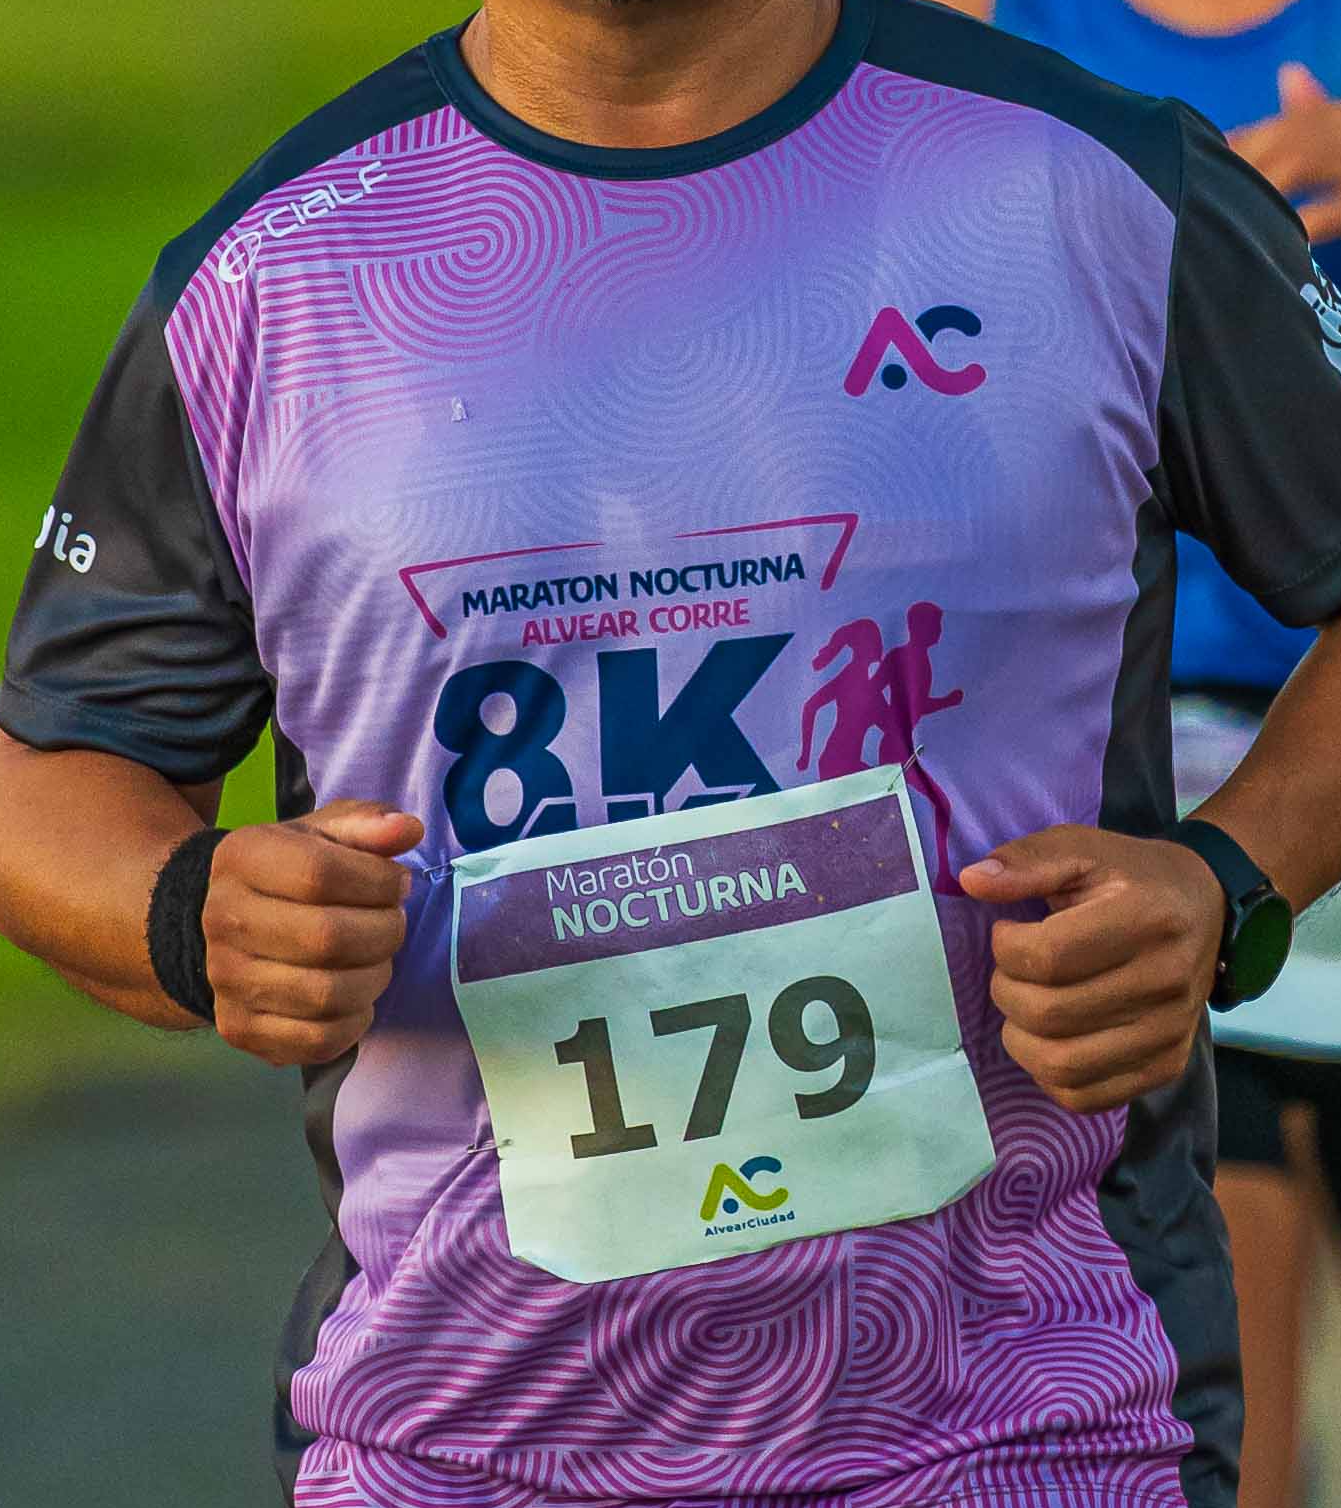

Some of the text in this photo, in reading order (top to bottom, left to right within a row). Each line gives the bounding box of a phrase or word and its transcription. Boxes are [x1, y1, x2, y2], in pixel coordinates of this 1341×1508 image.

[463, 553, 805, 618] MARATON NOCTURNA
[521, 598, 751, 648] ALVEAR CORRE
[434, 632, 795, 852] 8K
[546, 846, 694, 901] Maratón
[551, 863, 808, 941] NOCTURNA
[553, 975, 877, 1160] 179
[704, 1210, 796, 1237] AlvearCiudad
